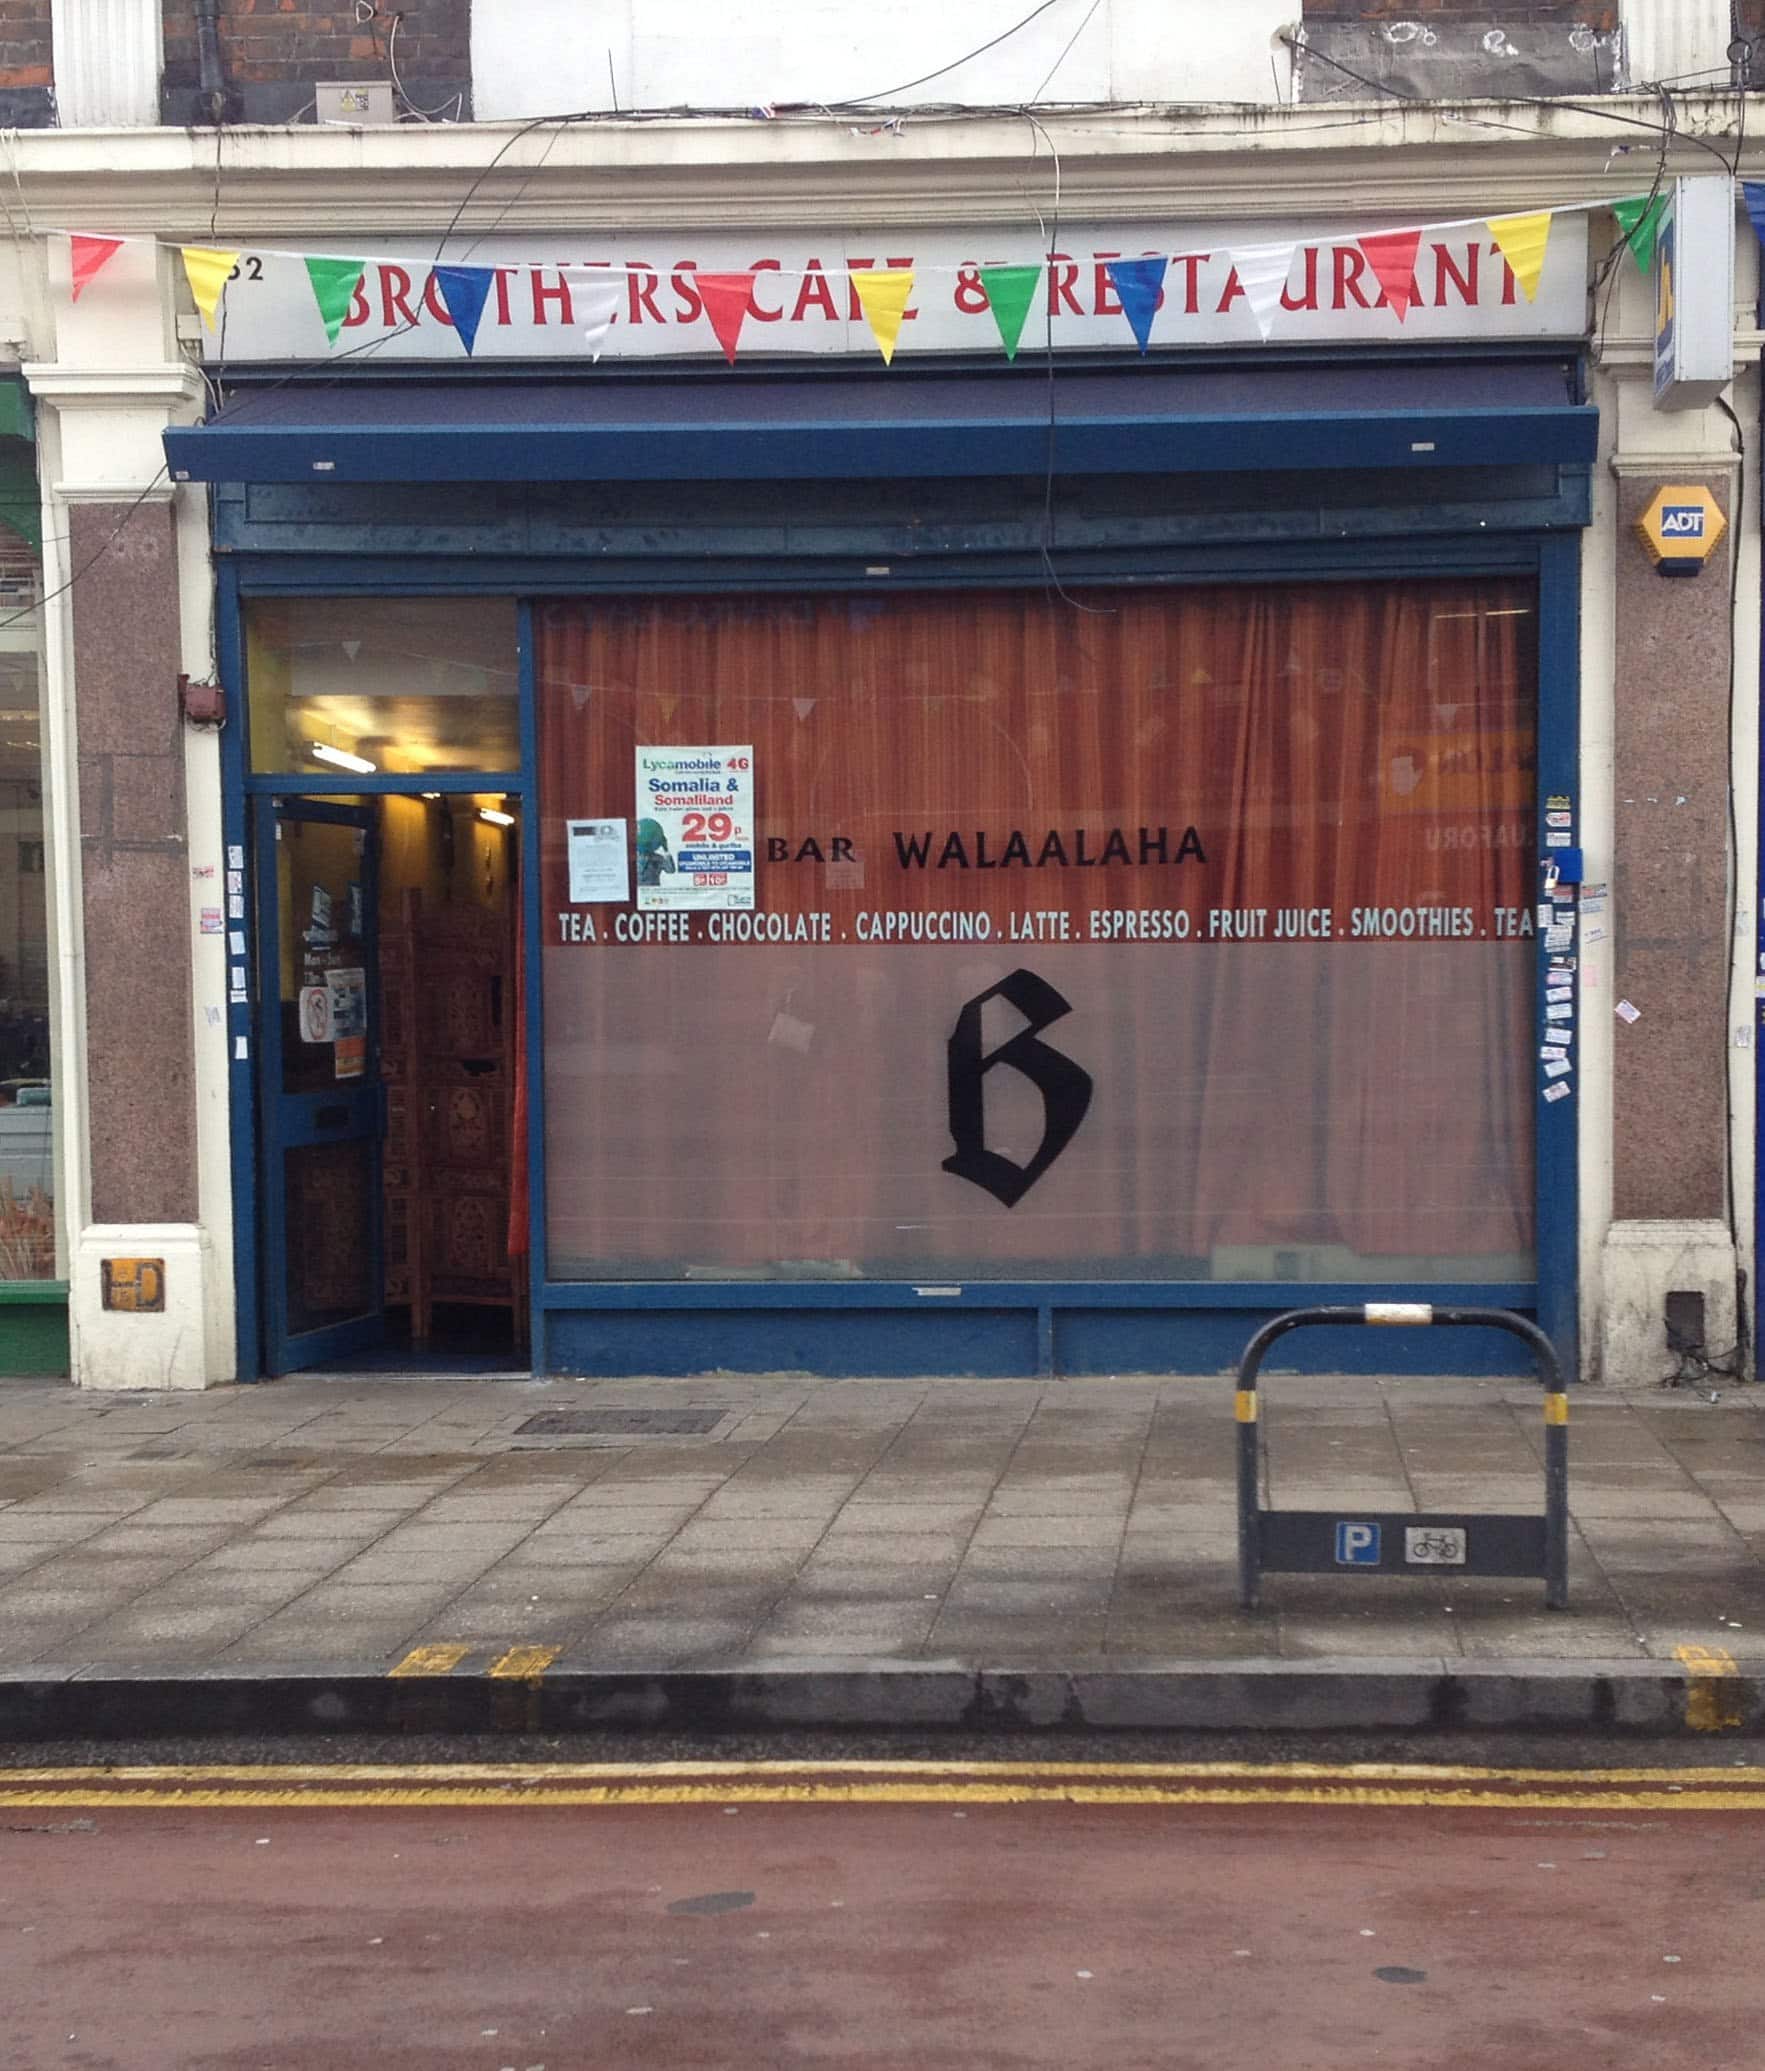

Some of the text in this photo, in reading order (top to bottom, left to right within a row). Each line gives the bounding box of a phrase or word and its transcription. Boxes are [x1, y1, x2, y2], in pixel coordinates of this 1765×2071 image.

[340, 259, 702, 327] BRTHRS
[1661, 512, 1704, 532] ADT
[643, 757, 749, 772] Lycamobile 4G
[648, 777, 739, 793] Somalia &
[654, 794, 734, 806] Somaliland
[682, 812, 732, 842] 29
[766, 825, 1208, 870] BAR WALAALAHA
[558, 912, 597, 943] TEA
[614, 912, 690, 942] COFFEE
[707, 912, 831, 942] CHOCOLATE
[855, 910, 991, 941] CAPPUCCINO
[1009, 911, 1070, 940] LATTE
[1089, 909, 1190, 940] ESPRESSO
[1209, 909, 1267, 938] FRUIT
[1273, 908, 1332, 938] JUICE
[1351, 907, 1474, 938] SMOOTHIES
[1494, 907, 1534, 937] TEA
[1344, 1525, 1373, 1561] P
